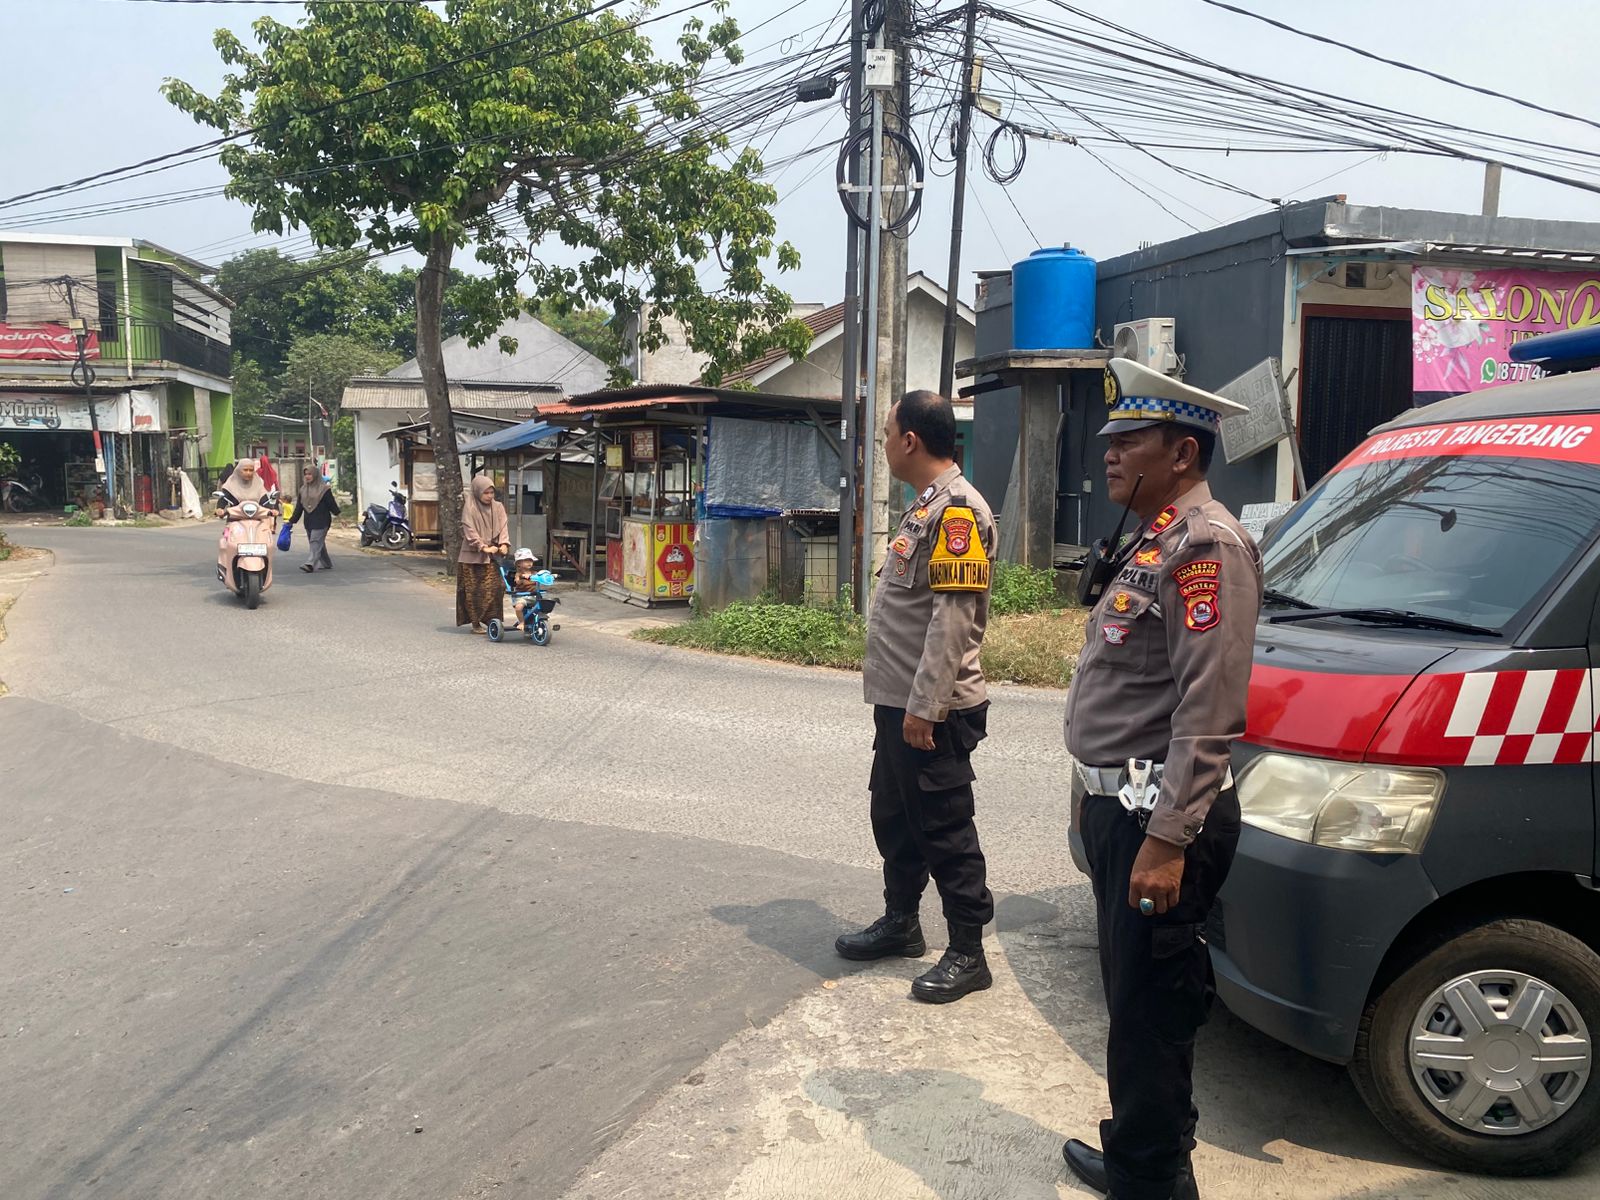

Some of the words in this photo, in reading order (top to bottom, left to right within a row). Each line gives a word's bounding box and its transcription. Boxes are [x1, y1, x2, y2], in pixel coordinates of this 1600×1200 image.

[1424, 284, 1569, 325] SALON
[1, 402, 58, 418] MOTOR
[1362, 427, 1449, 457] POLRESTA
[1443, 423, 1593, 449] TANGERANG
[1241, 504, 1269, 518] LINA
[1118, 568, 1155, 588] POLRI
[1176, 563, 1217, 577] POLRESTA
[1183, 582, 1216, 594] BANTEN
